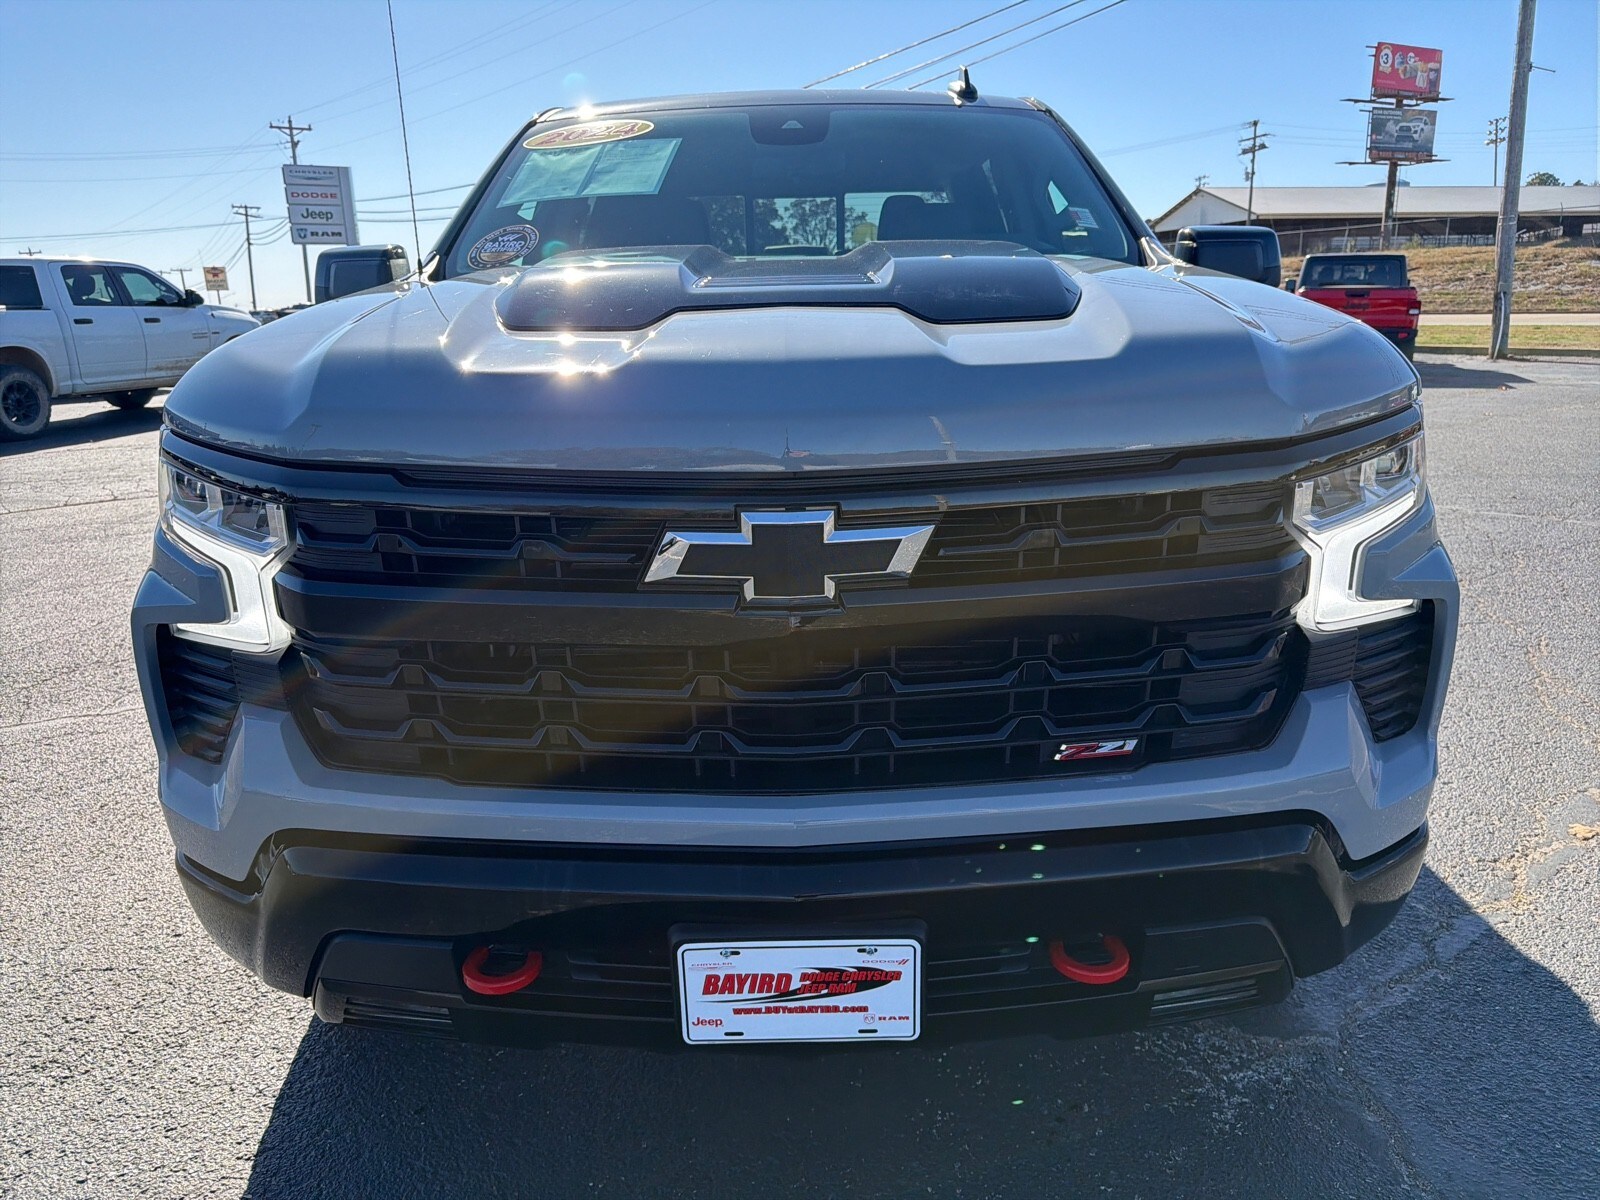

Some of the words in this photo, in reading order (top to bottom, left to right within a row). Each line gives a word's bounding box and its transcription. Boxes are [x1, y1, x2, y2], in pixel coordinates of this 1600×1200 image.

[535, 122, 641, 146] 2024
[301, 208, 334, 221] Jeep
[483, 240, 525, 249] BAYIRD
[1054, 740, 1138, 760] Z71
[799, 971, 841, 983] DODGE
[841, 970, 903, 982] CHRYSLER
[702, 973, 793, 995] BAYIRD
[796, 983, 828, 994] JEEP
[828, 982, 857, 994] RAM
[692, 1016, 724, 1028] Jeep
